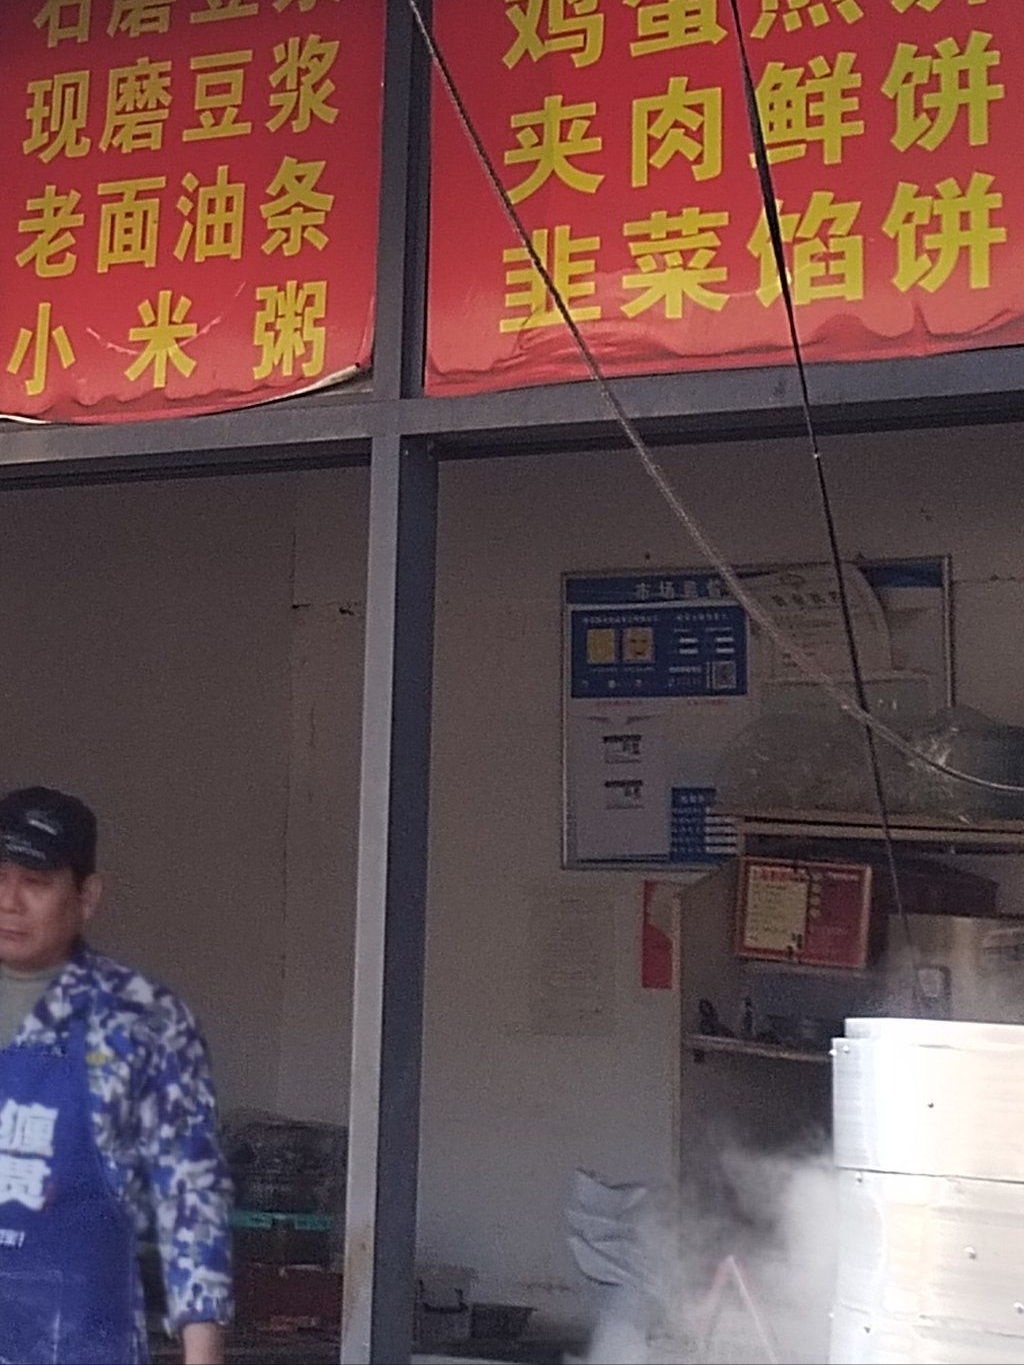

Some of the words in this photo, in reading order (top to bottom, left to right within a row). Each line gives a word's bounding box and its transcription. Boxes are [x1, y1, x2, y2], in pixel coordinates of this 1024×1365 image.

[22, 33, 341, 165] 现磨豆浆
[499, 31, 1006, 206] 夹肉鲜饼
[15, 156, 336, 280] 老面油条
[499, 171, 1008, 334] 韭菜馅饼
[6, 279, 328, 397] 小米粥
